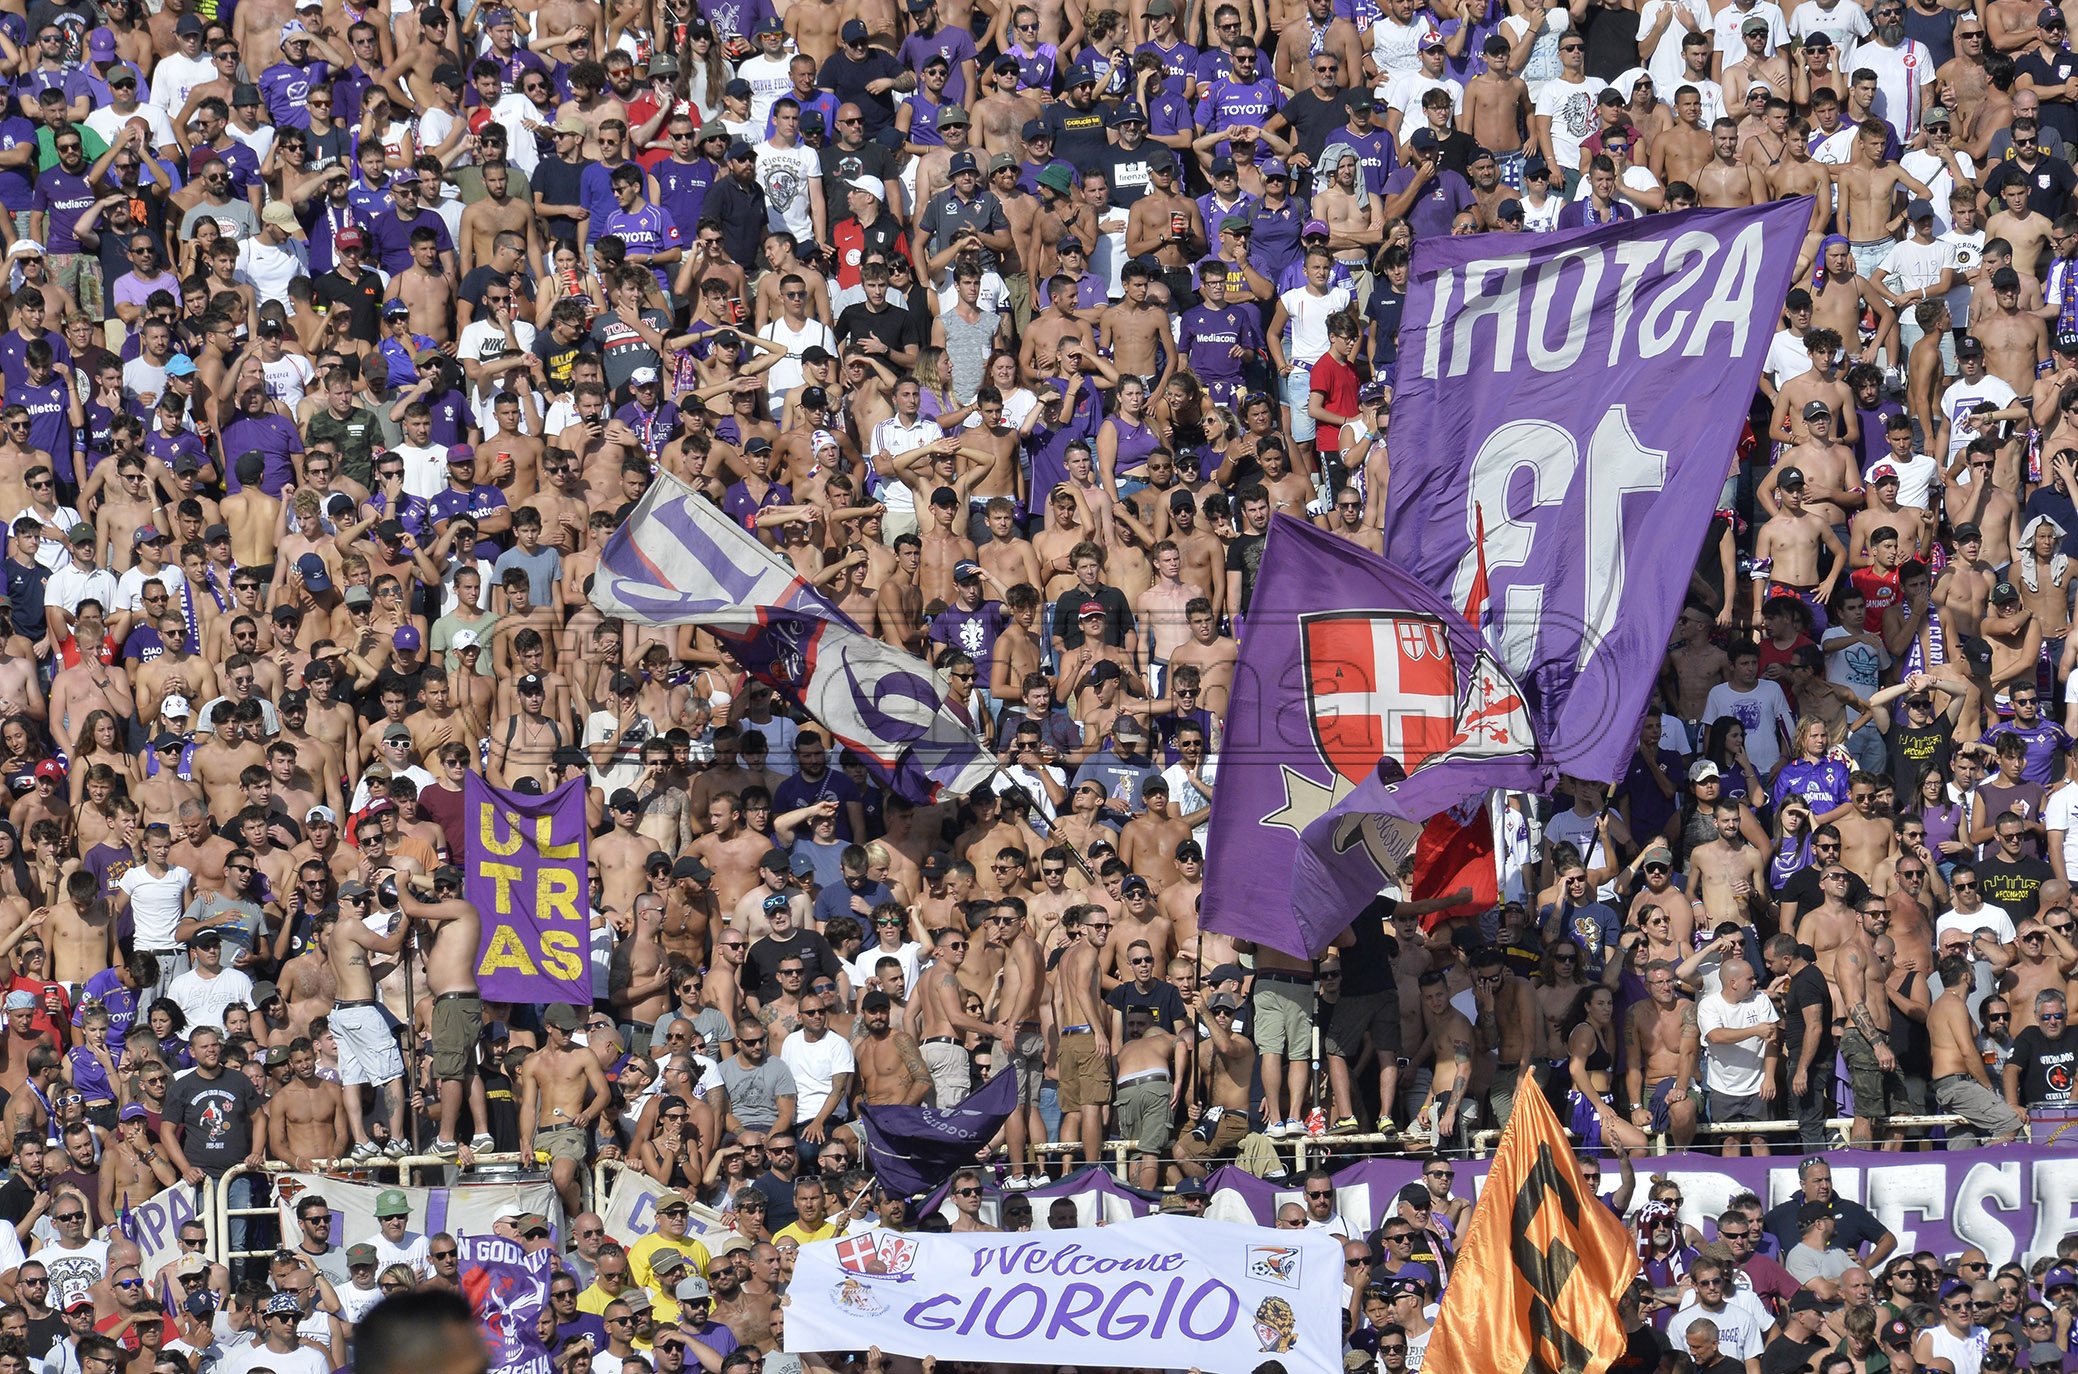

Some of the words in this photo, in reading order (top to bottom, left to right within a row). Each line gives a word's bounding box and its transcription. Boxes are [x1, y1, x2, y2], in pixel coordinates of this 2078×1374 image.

[1197, 333, 1237, 344] Mediacom
[142, 646, 163, 656] CIAO
[970, 1240, 1188, 1277] Welcome
[903, 1275, 1241, 1343] GIORGIO
